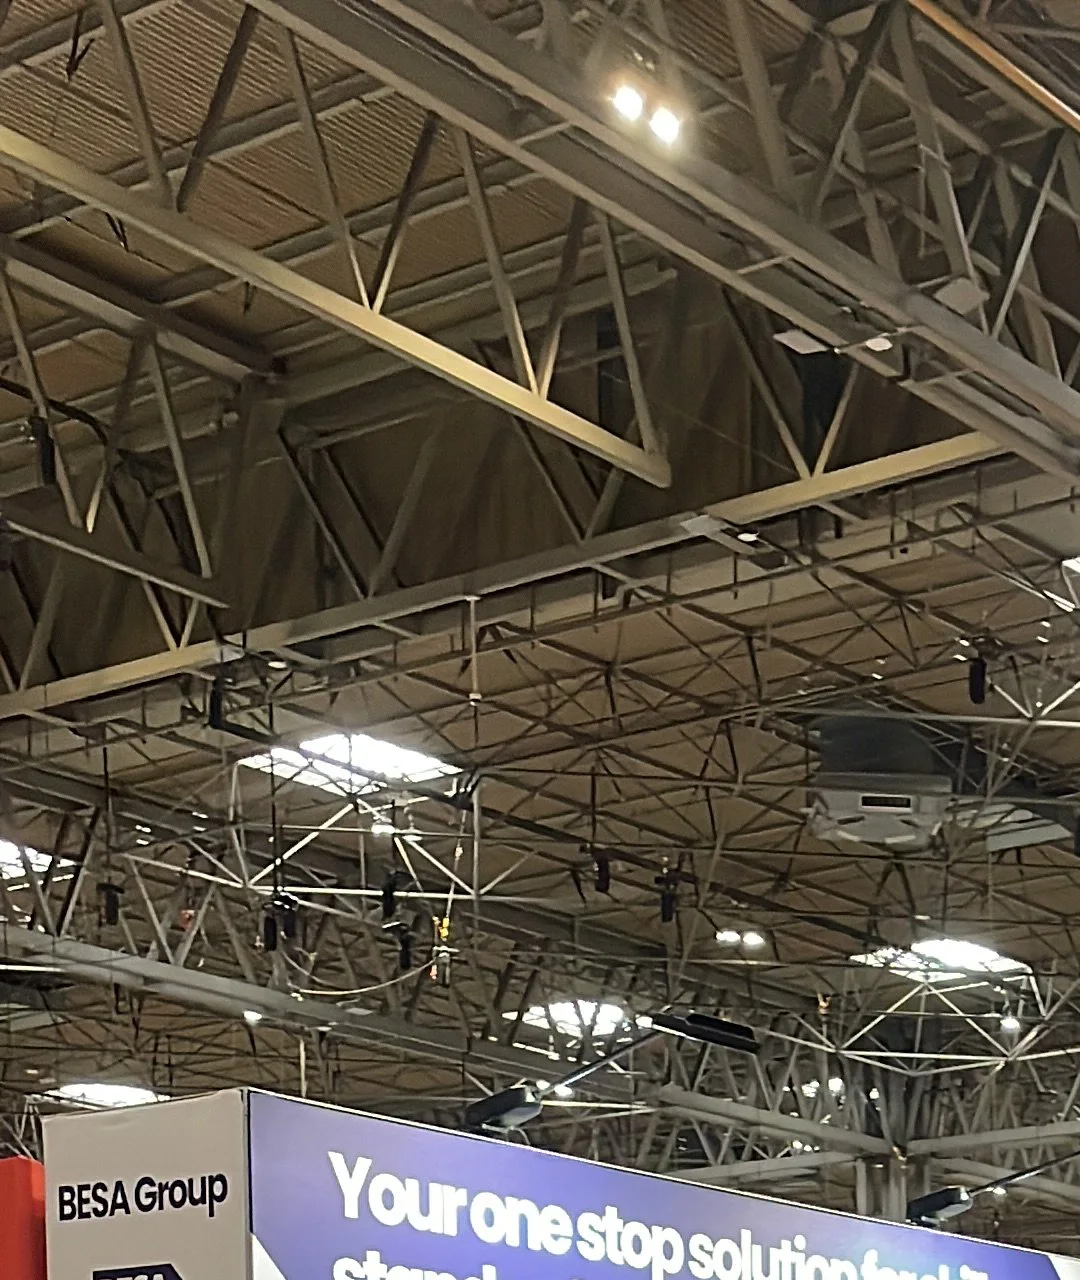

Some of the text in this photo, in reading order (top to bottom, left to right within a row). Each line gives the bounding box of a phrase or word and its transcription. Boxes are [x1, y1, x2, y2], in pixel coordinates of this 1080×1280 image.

[58, 1173, 228, 1221] BESA Group
[327, 1150, 467, 1237] Your
[469, 1190, 575, 1257] one
